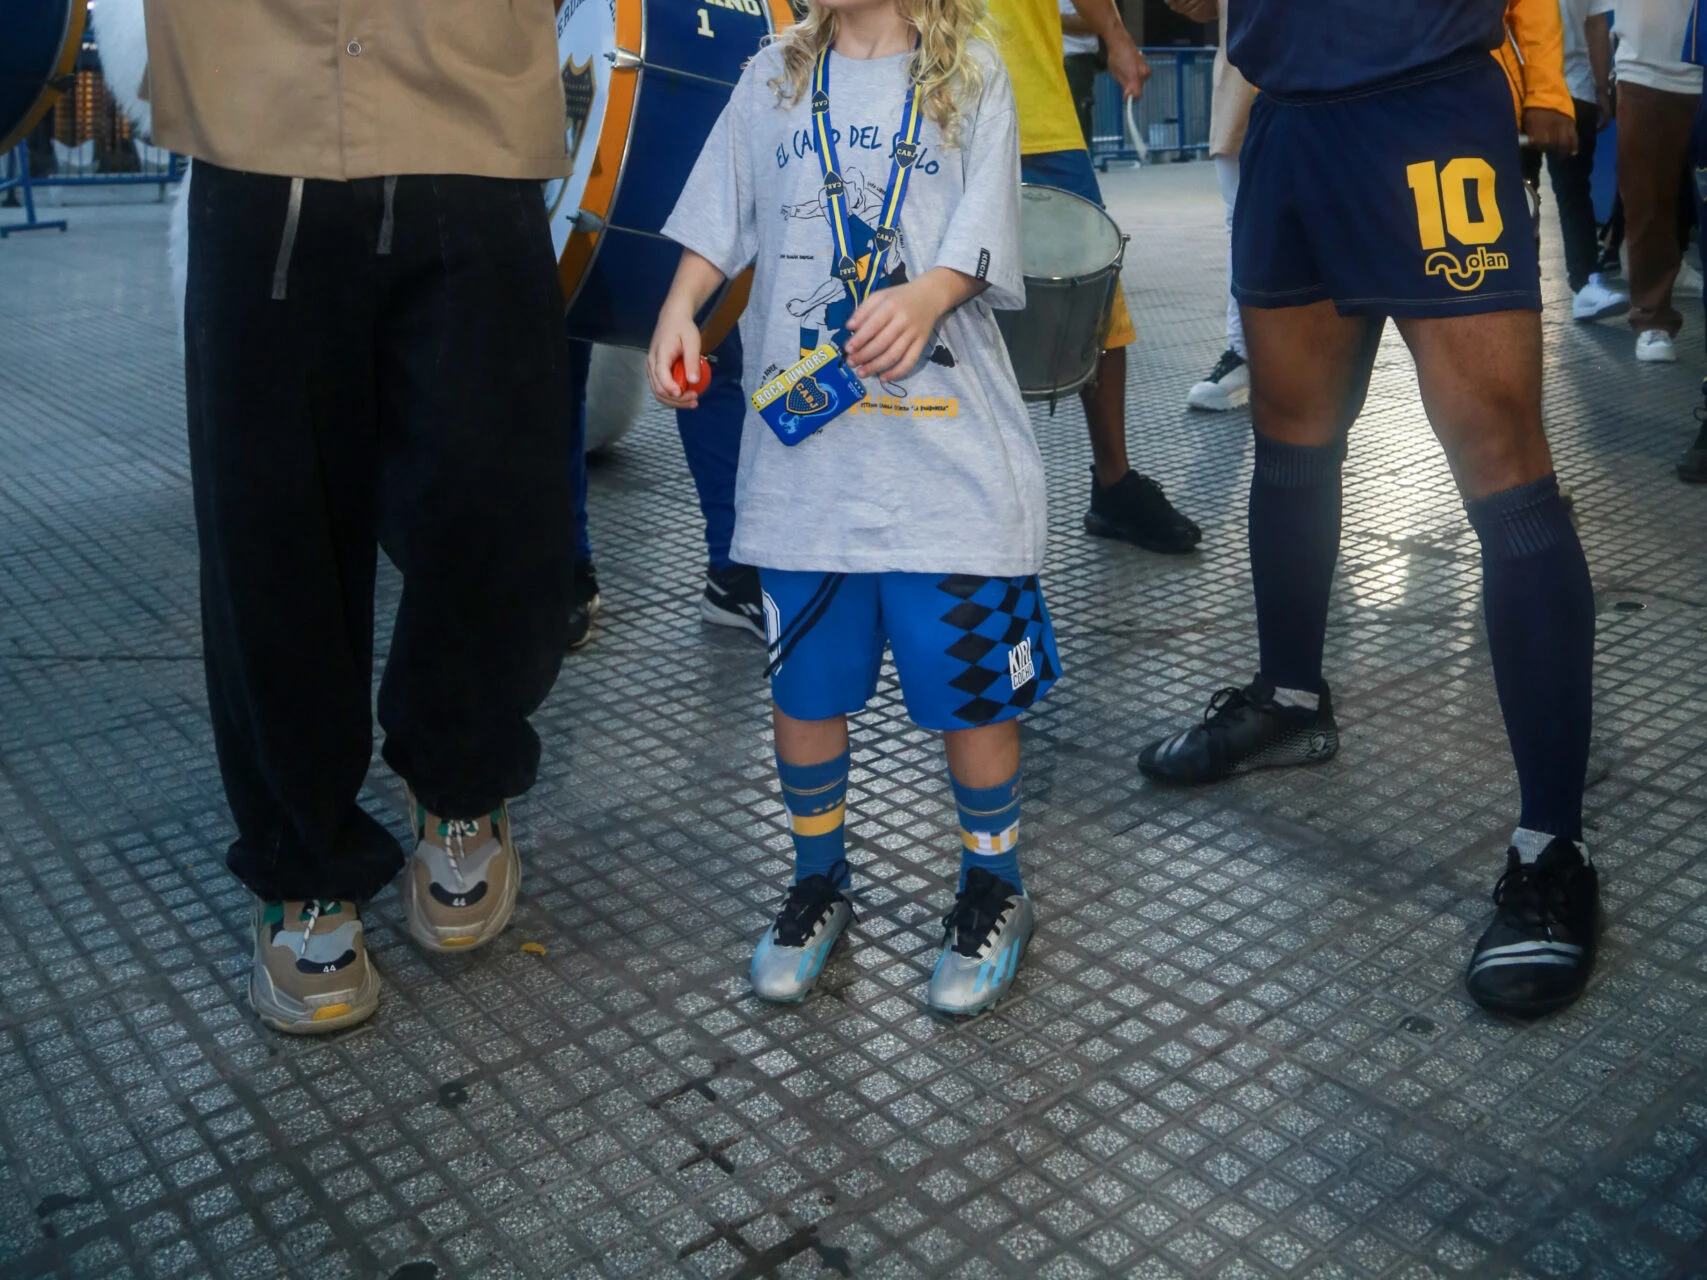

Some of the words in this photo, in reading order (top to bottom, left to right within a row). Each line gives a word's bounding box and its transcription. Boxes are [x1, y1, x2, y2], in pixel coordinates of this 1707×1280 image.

[696, 7, 716, 39] 1
[776, 142, 790, 169] EL
[849, 125, 883, 150] DEL
[1406, 157, 1504, 251] 10
[756, 380, 786, 405] BOCA
[784, 349, 828, 385] JUNIORS
[796, 382, 819, 409] CABJ
[1007, 636, 1032, 675] KIRI
[322, 964, 337, 973] 44
